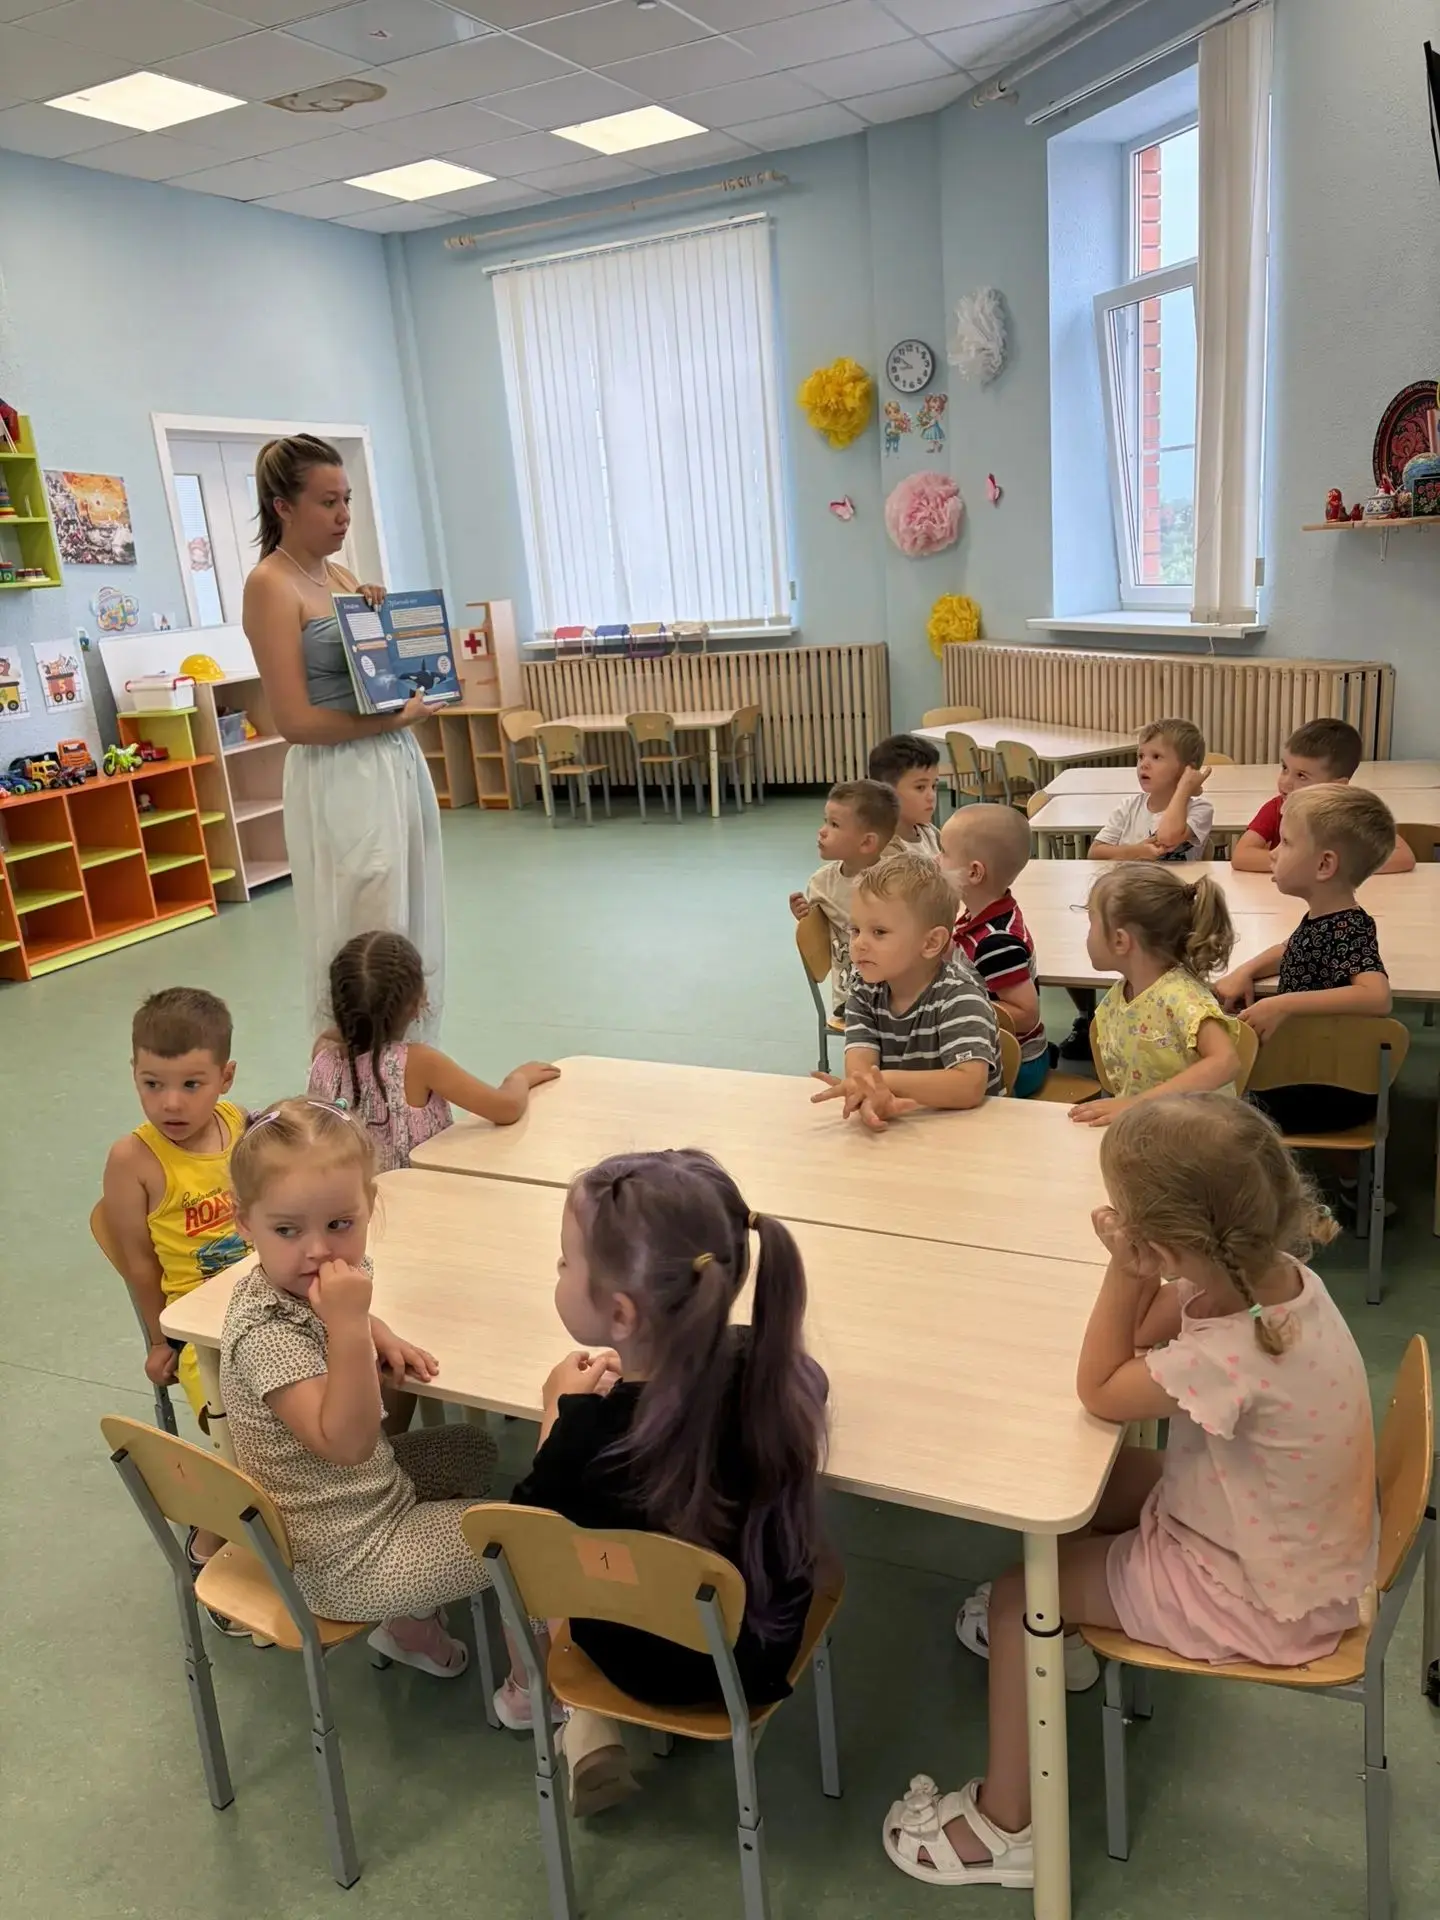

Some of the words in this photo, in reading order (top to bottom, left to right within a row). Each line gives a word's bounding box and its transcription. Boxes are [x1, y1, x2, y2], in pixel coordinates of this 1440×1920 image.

[58, 679, 66, 691] 5
[177, 1463, 185, 1478] 1
[600, 1551, 610, 1570] 1
